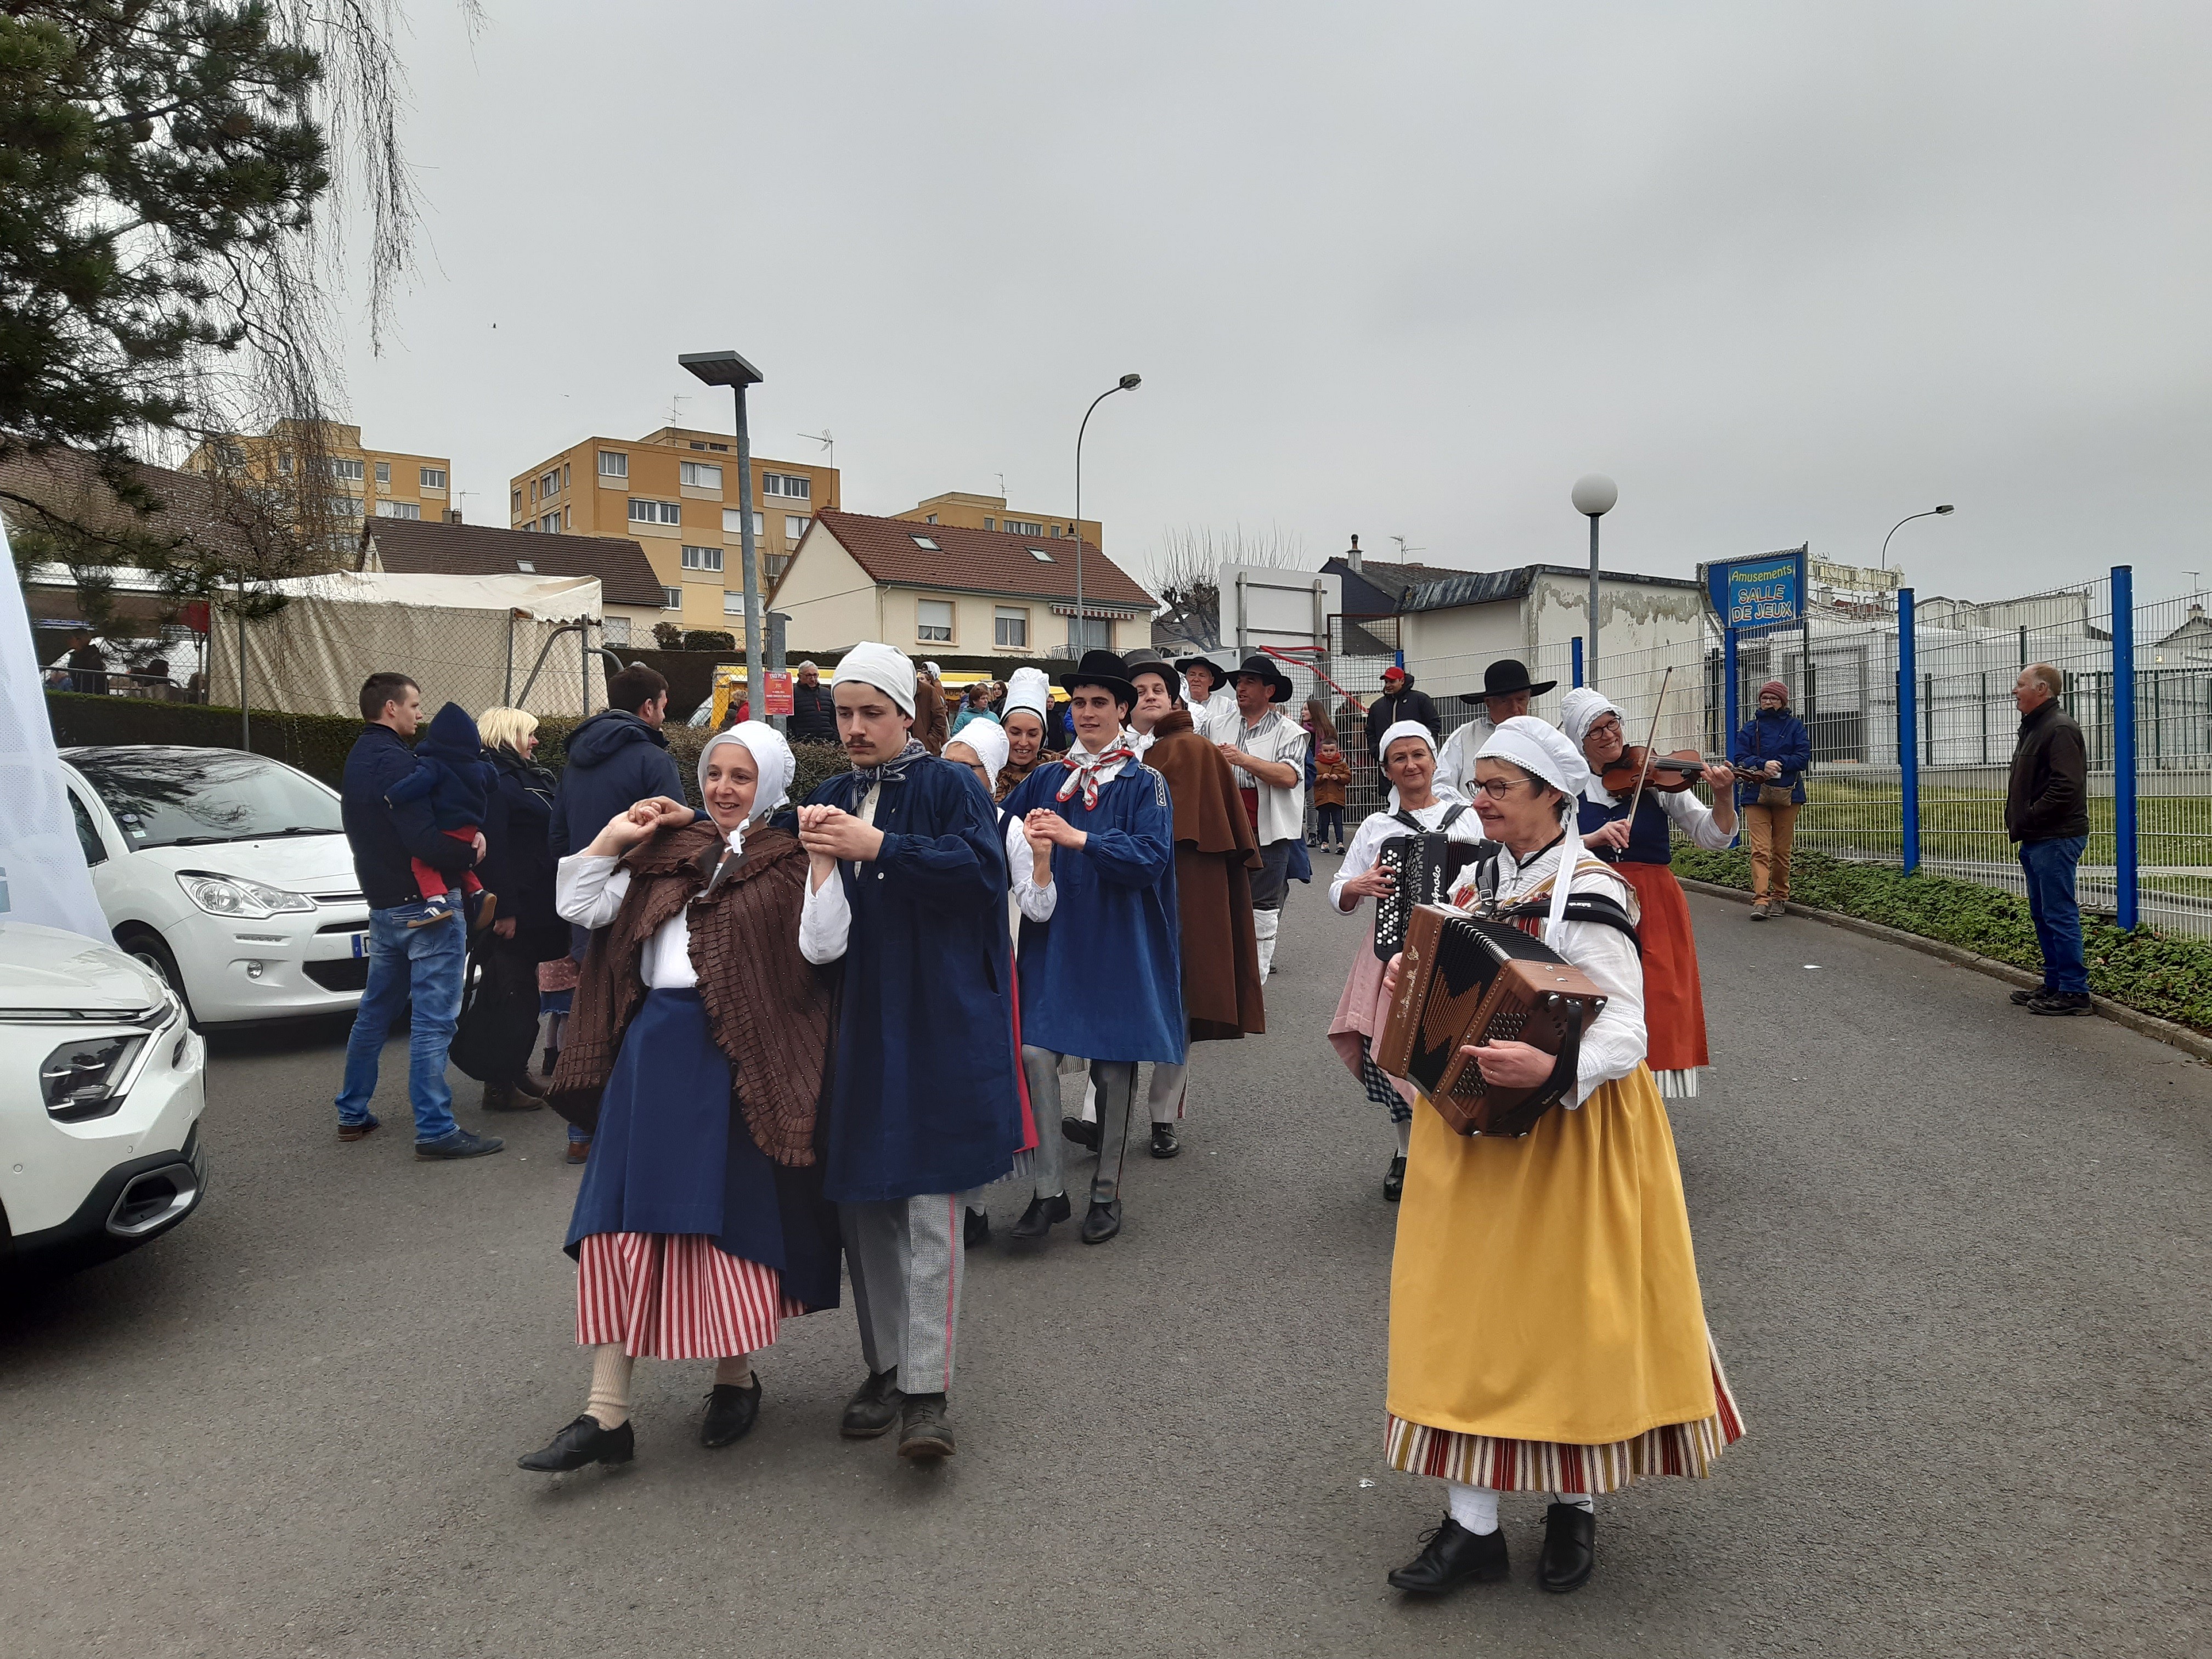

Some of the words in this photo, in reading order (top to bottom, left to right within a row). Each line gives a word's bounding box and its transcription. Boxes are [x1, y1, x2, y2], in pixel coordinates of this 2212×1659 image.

[1731, 565, 1792, 583] Amusements
[1739, 584, 1785, 605] SALLE
[1731, 606, 1752, 622] DE
[1754, 601, 1792, 619] JEUX
